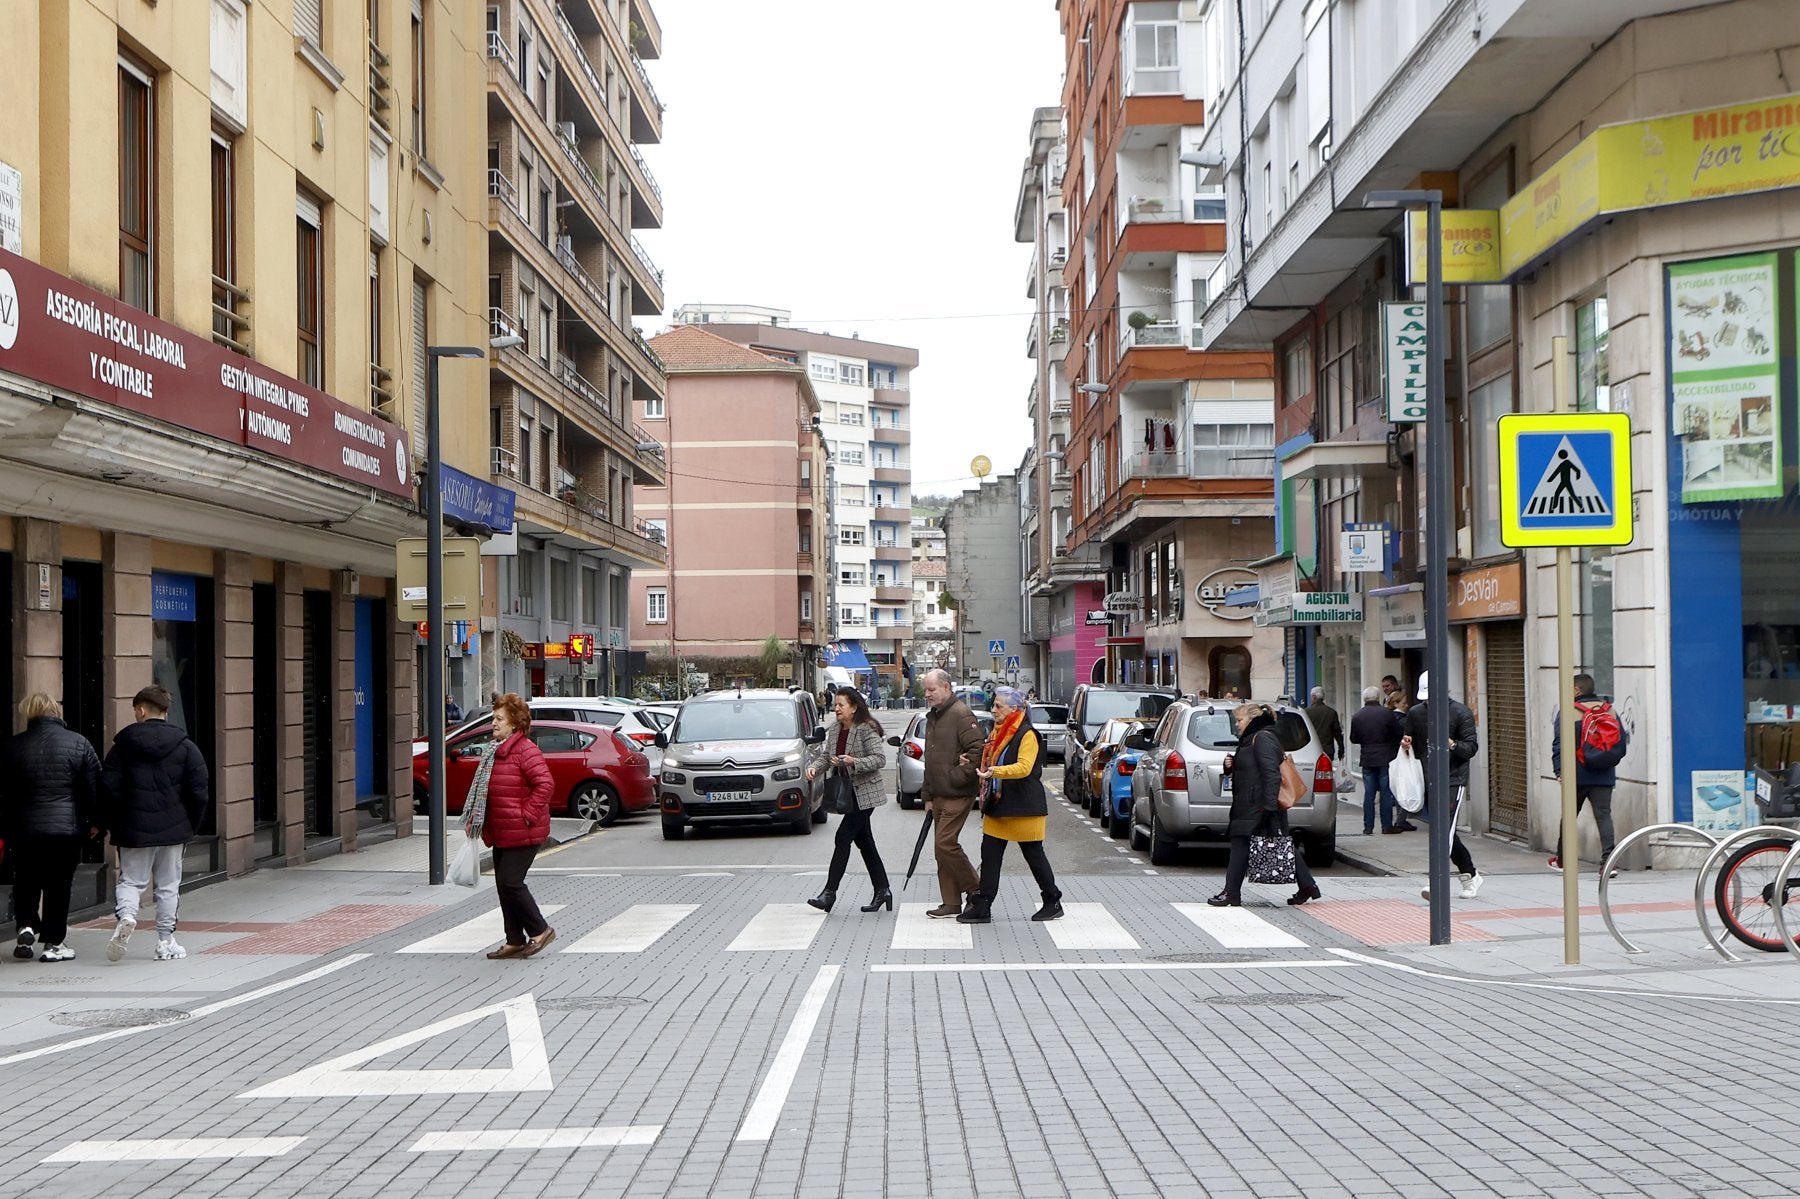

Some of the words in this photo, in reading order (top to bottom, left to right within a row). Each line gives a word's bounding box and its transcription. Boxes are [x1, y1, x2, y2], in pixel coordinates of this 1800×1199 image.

[1693, 143, 1742, 182] por
[1415, 227, 1492, 241] Mramos
[1676, 278, 1714, 290] AYUDAS
[46, 288, 102, 336] ASESORÍA
[103, 312, 143, 356] FISCAL,
[143, 329, 187, 370] LABORAL
[90, 352, 98, 379] Y
[100, 356, 153, 399] CONTABLE
[1396, 306, 1426, 417] CAMPILLO
[220, 363, 254, 396] GESTIÓN
[255, 377, 287, 410] INTEGRAL
[287, 390, 309, 418] PYMES
[1677, 383, 1756, 396] ACCESIBILIDAD
[238, 408, 244, 430] Y
[248, 410, 291, 445] AUTÓNOMOS
[334, 410, 378, 446] ADMINISTRACIÓN
[378, 431, 386, 449] DE
[342, 446, 380, 476] COMUNIDADES
[443, 476, 474, 511] ASESORÍA
[1306, 593, 1350, 605] AGUSTIN
[1458, 571, 1498, 607] Desván
[1294, 609, 1362, 621] Inmobiliaria
[712, 792, 732, 801] 5248
[733, 791, 749, 800] LMZ
